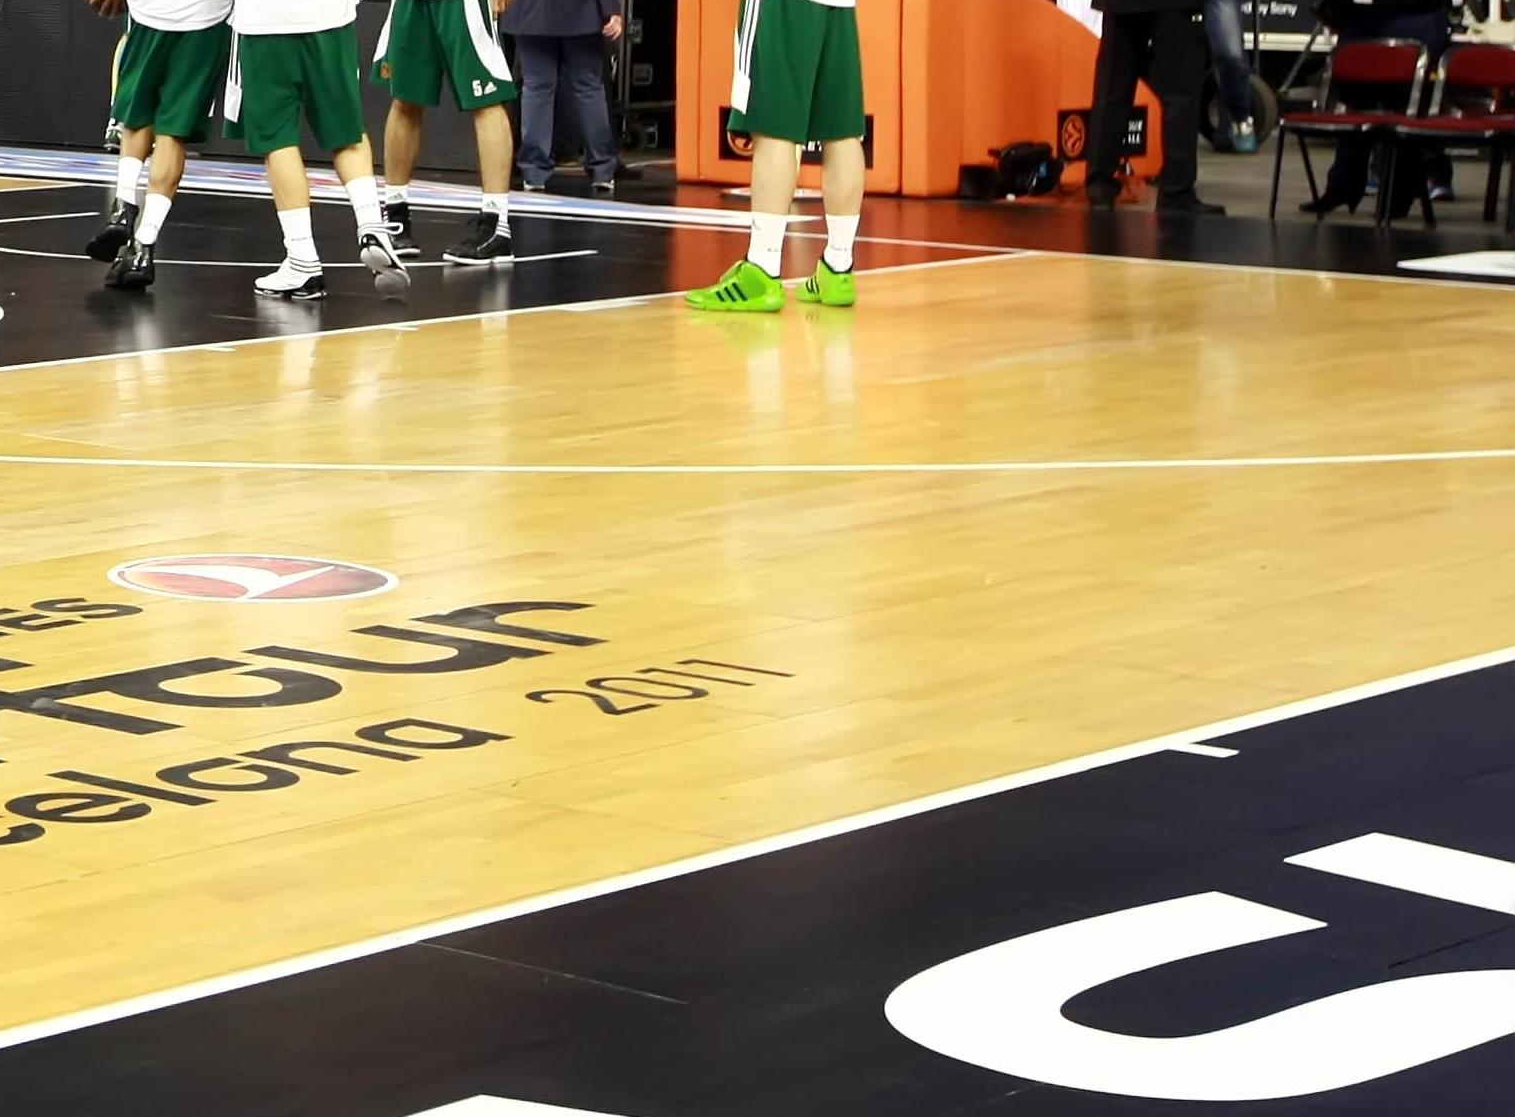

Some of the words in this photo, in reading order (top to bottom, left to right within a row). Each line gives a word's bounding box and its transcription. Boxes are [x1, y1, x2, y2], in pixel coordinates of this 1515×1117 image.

[1270, 0, 1298, 18] Sony
[472, 79, 483, 97] 5
[525, 659, 792, 716] 2011
